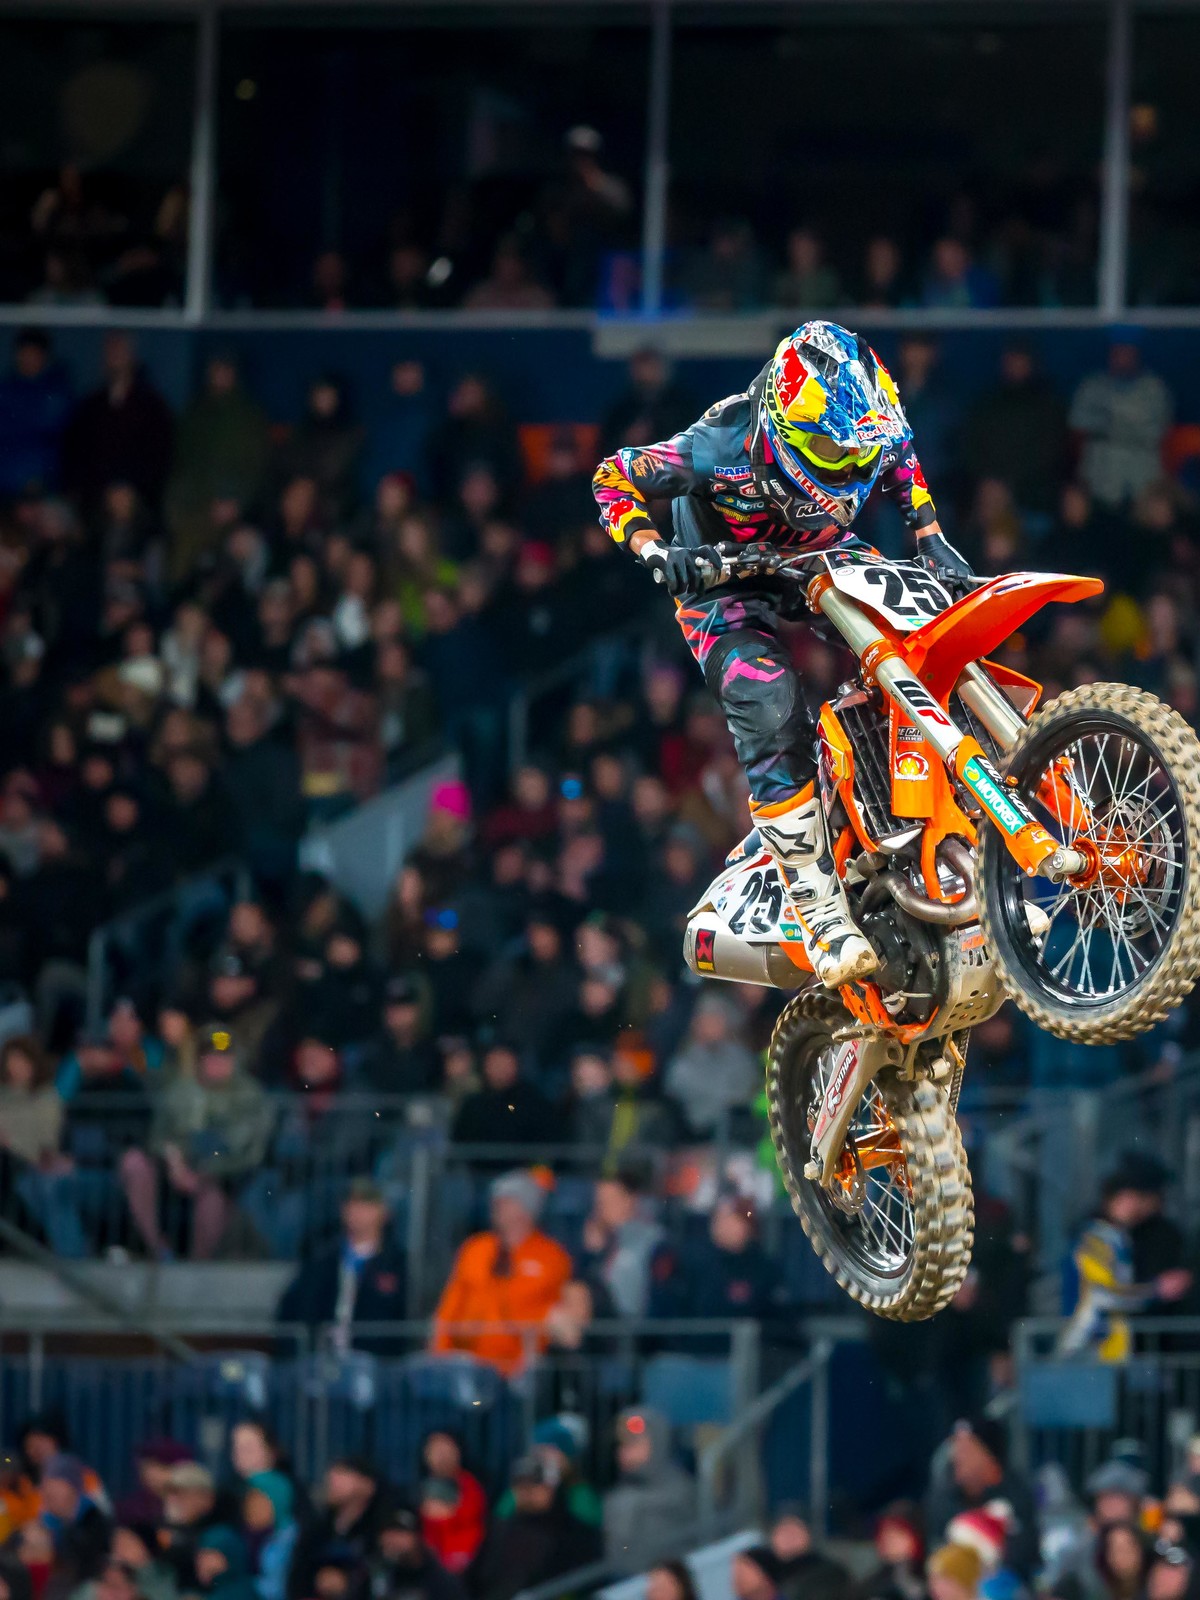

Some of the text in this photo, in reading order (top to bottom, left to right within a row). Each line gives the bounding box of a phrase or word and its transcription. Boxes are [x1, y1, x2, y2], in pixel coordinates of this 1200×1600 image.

[857, 425, 882, 440] Red
[715, 466, 752, 476] PART
[736, 500, 764, 510] MOTO
[800, 478, 838, 513] Bull
[864, 567, 949, 616] 25
[893, 680, 952, 726] WP
[974, 779, 1025, 832] MOTOREX
[976, 757, 1037, 823] DULOP
[728, 868, 783, 934] 25
[827, 1049, 855, 1117] RENTHAL
